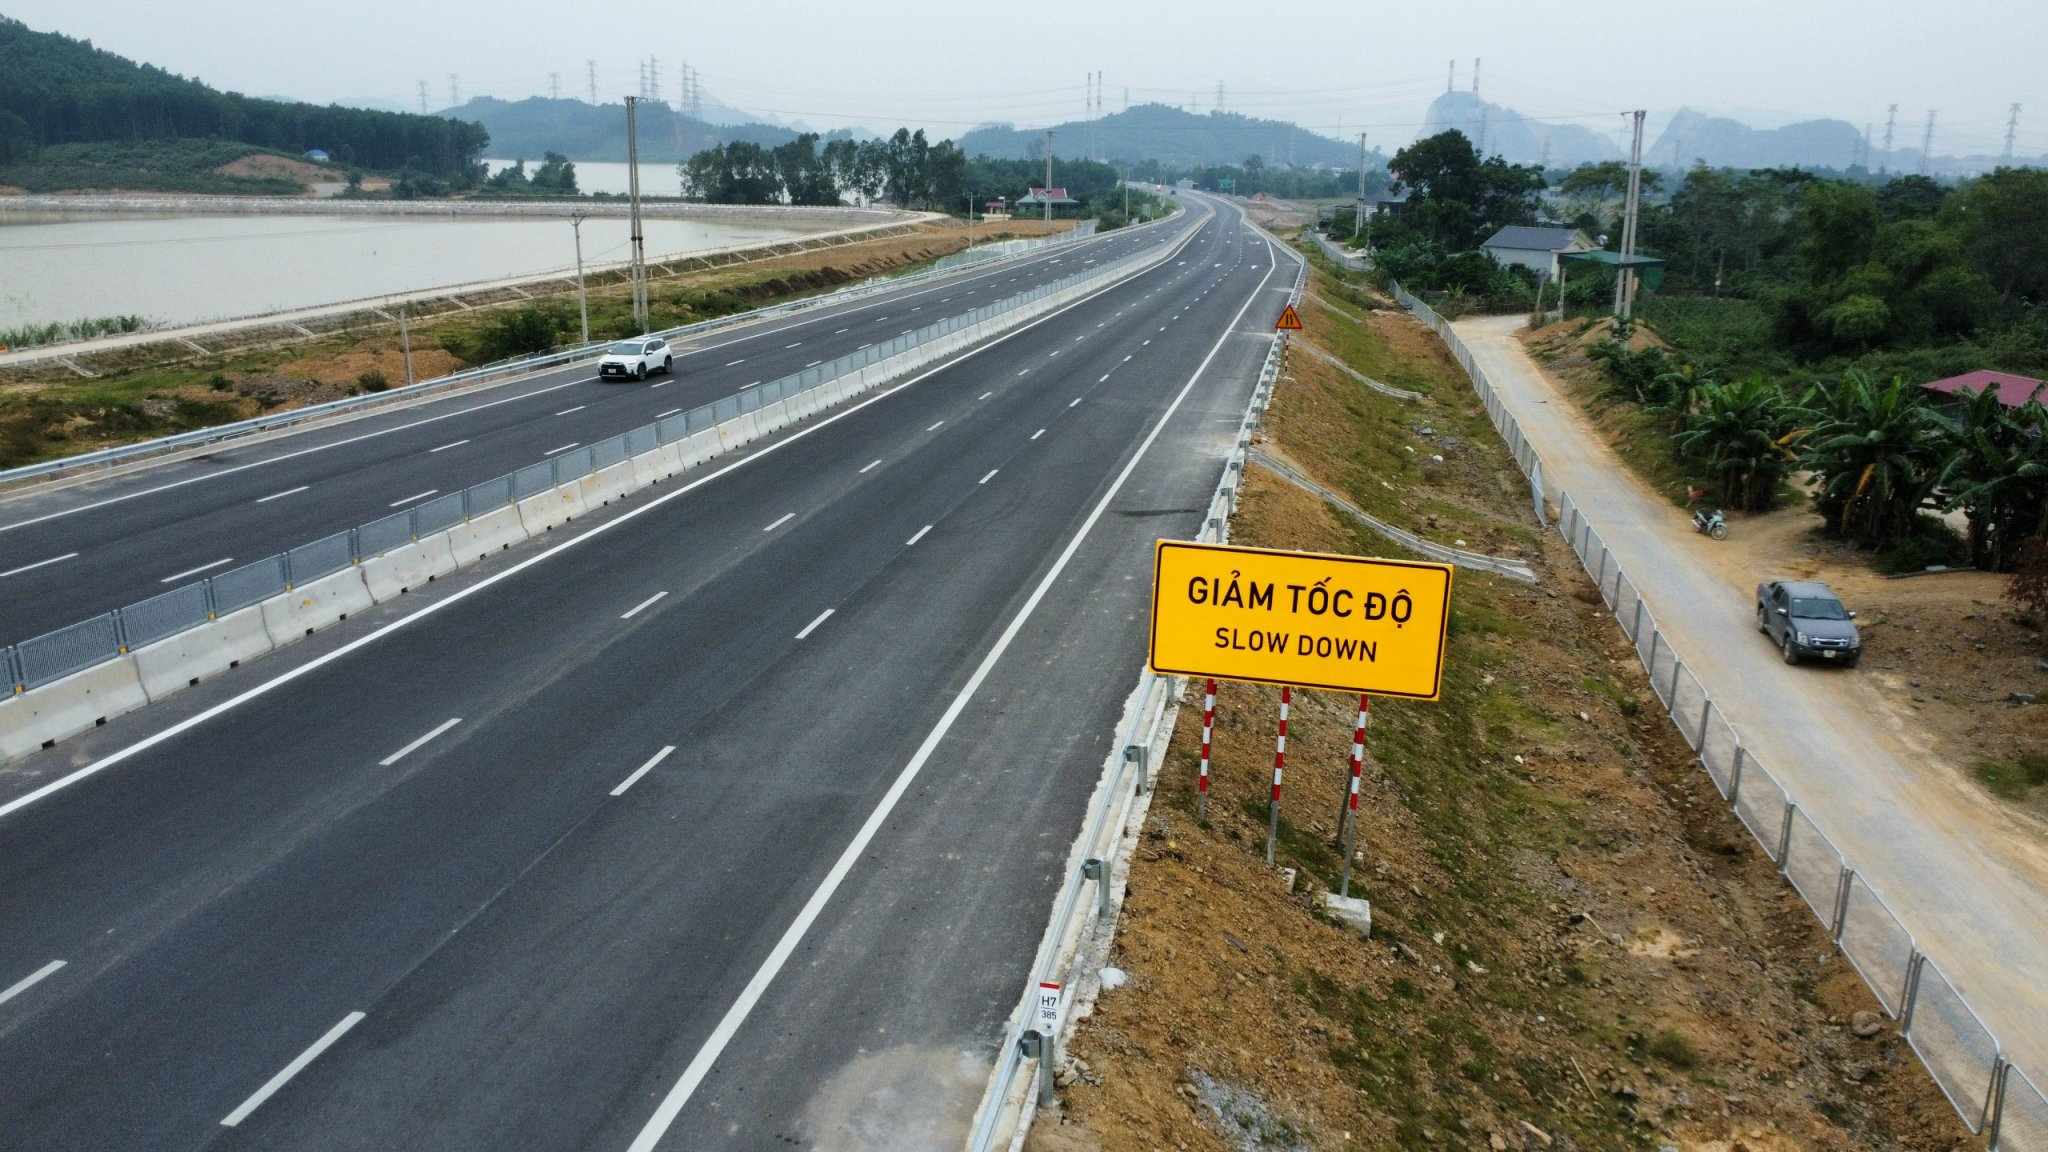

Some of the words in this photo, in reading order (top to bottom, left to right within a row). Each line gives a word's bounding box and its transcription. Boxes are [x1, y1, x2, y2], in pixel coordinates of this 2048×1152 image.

[1188, 570, 1274, 611] GIẢM
[1287, 577, 1352, 617] TỐC
[1364, 588, 1413, 628] ĐỘ
[1215, 627, 1289, 654] SLOW
[1298, 635, 1377, 663] DOWN
[1041, 995, 1057, 1007] H7
[1041, 1010, 1057, 1020] 385
